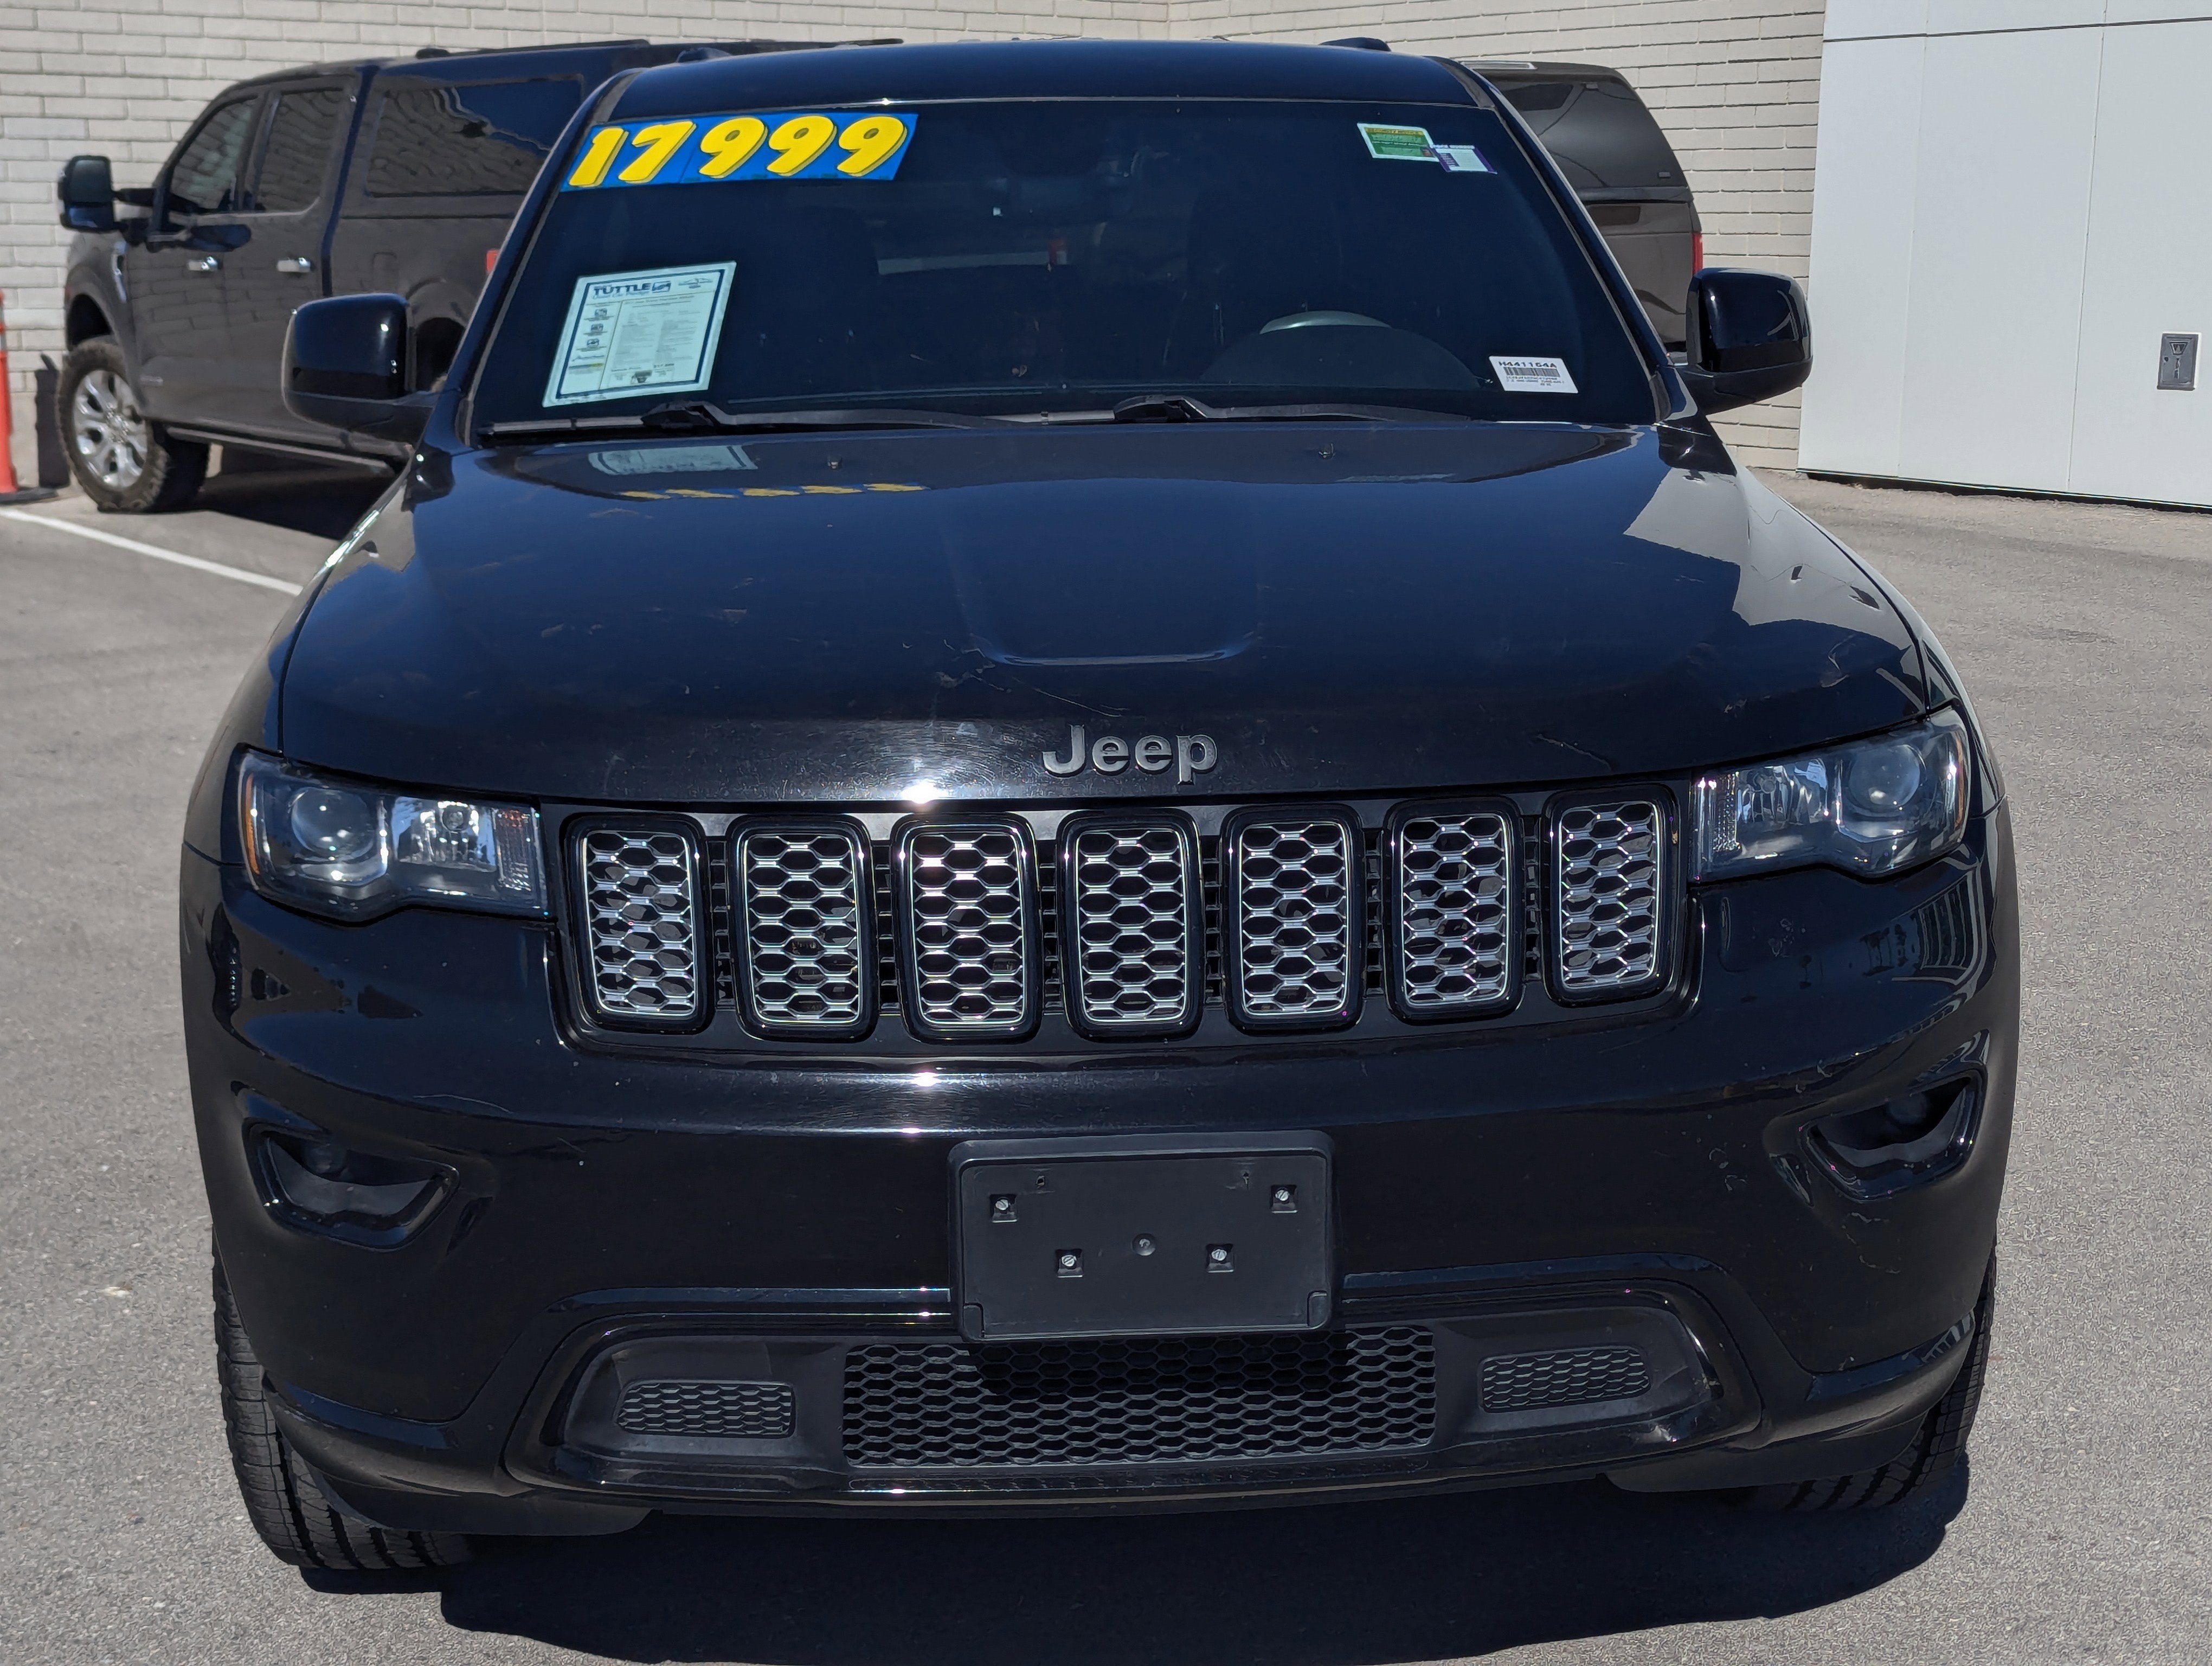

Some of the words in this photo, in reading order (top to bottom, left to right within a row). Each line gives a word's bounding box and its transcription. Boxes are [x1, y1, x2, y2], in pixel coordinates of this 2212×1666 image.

[568, 115, 908, 188] 17999
[594, 283, 652, 296] TUTTLE
[1041, 724, 1218, 785] Jeep
